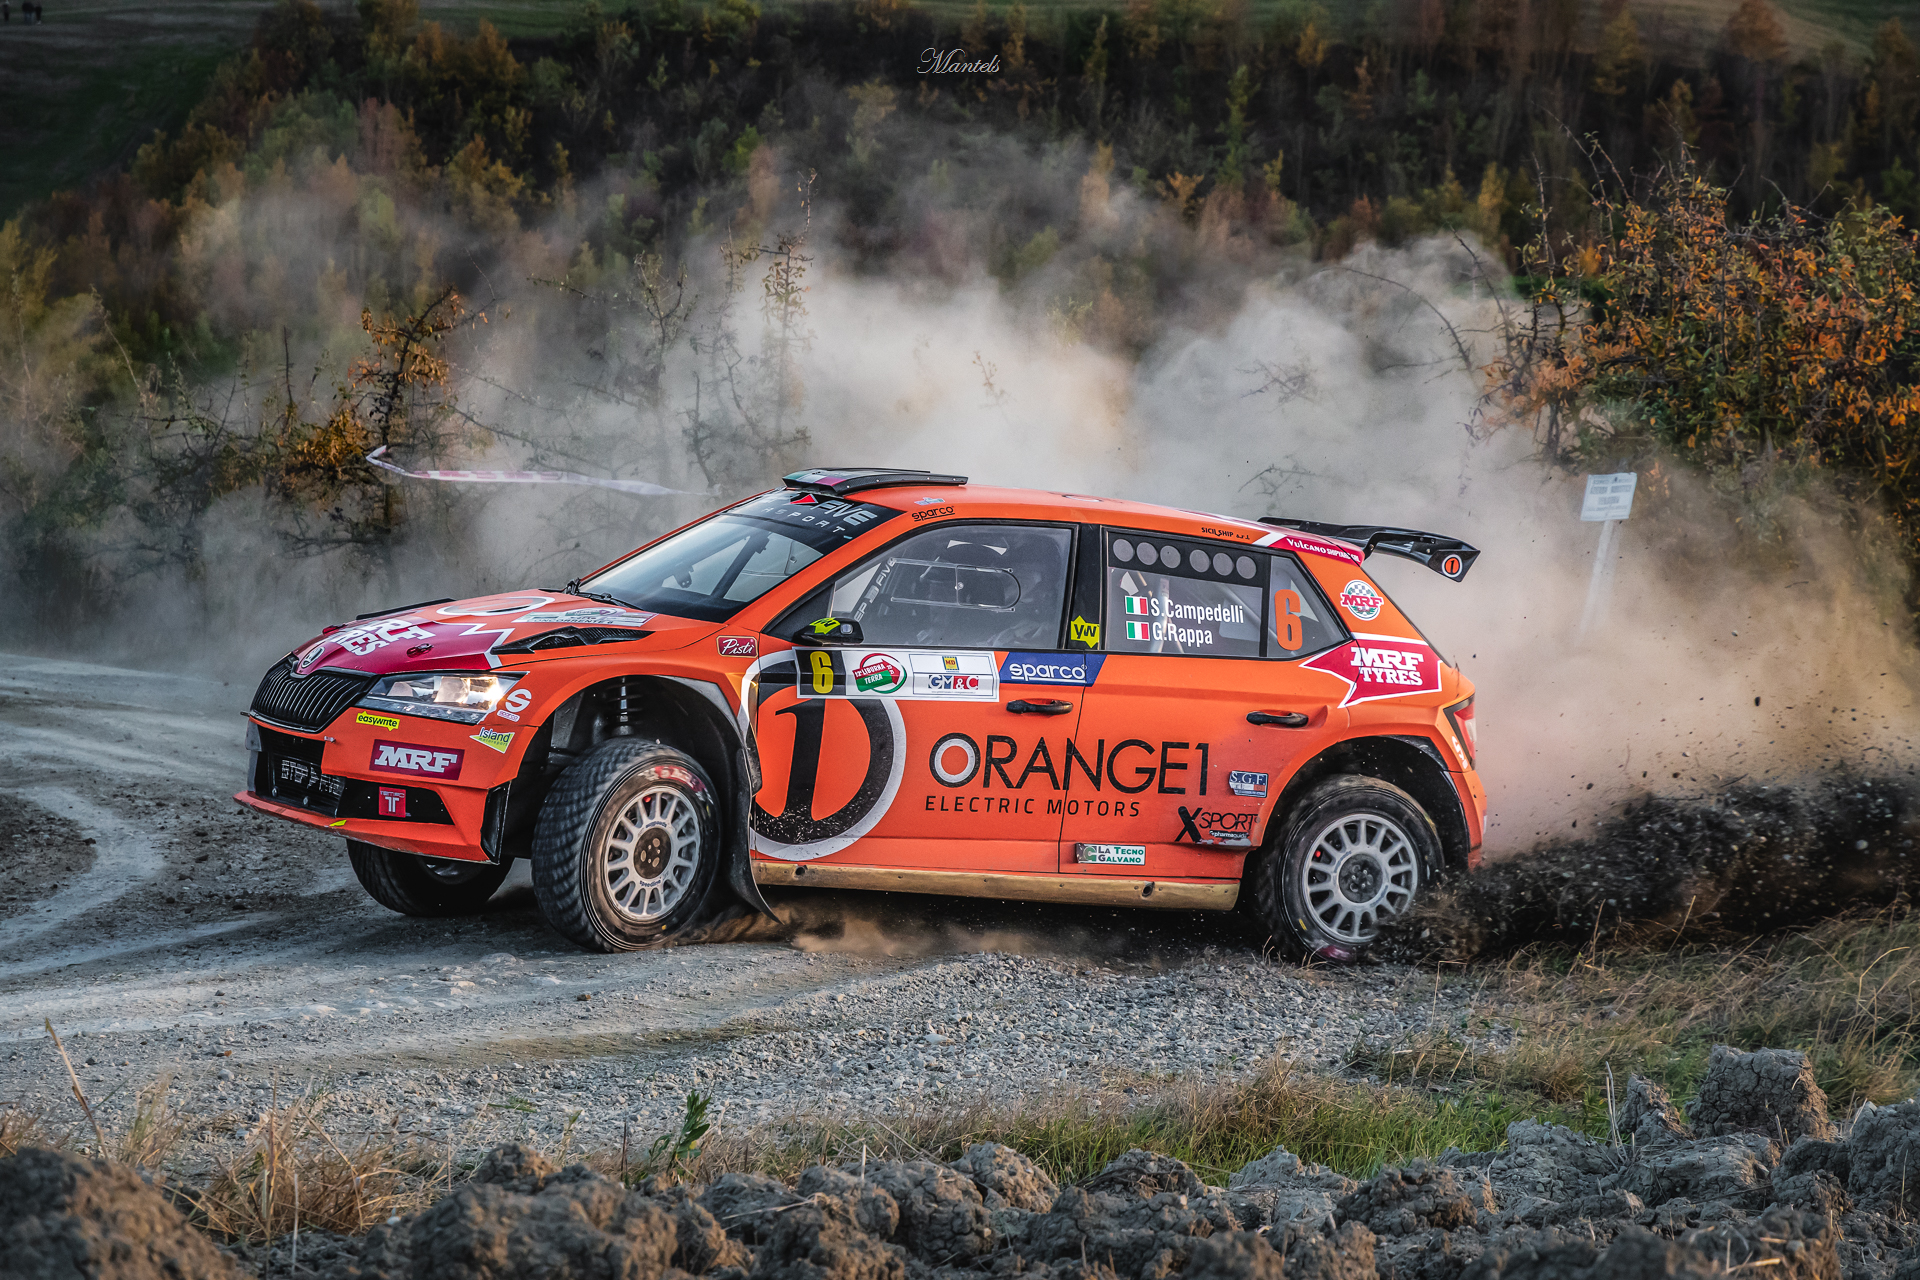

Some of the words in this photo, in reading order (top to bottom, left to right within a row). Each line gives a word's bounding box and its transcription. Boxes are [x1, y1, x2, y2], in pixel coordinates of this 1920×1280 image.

[911, 506, 955, 521] sparco
[1341, 593, 1383, 608] MRF
[1274, 588, 1304, 651] 6
[1350, 646, 1425, 671] MRF
[809, 650, 835, 694] 6
[864, 674, 884, 684] TERRA
[1009, 662, 1086, 683] sparco
[1359, 666, 1423, 686] TYRES
[358, 713, 399, 728] easywrite
[479, 727, 511, 743] Island
[374, 744, 459, 773] MRF
[929, 732, 1210, 796] ORANGE1
[925, 795, 1035, 815] ELECTRIC
[1046, 798, 1142, 818] MOTORS
[1098, 853, 1142, 864] GALVANO
[1114, 846, 1144, 856] TECNO
